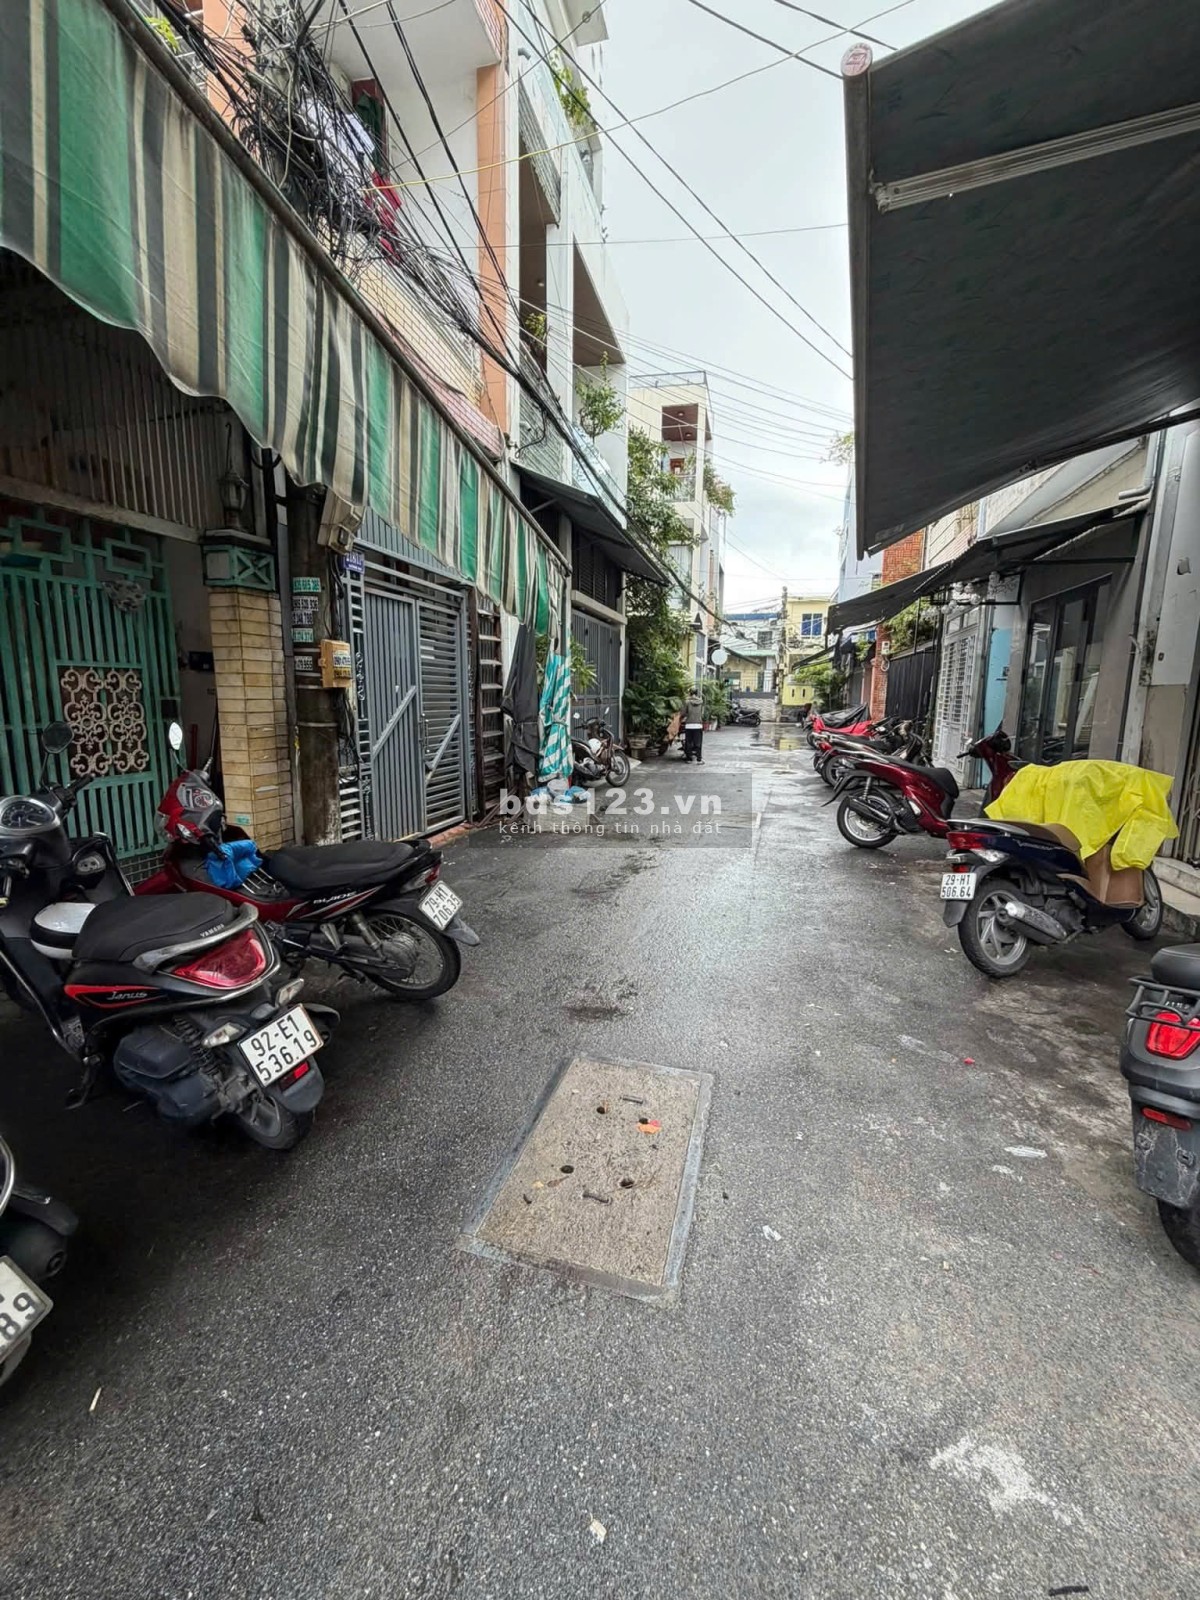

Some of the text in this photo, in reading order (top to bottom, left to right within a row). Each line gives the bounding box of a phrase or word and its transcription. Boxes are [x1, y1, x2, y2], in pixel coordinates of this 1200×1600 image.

[941, 886, 971, 898] 506.64
[200, 923, 225, 938] YAMAHA
[107, 991, 148, 1000] Janus
[250, 1014, 300, 1057] 92-E1
[255, 1029, 317, 1081] 536.19
